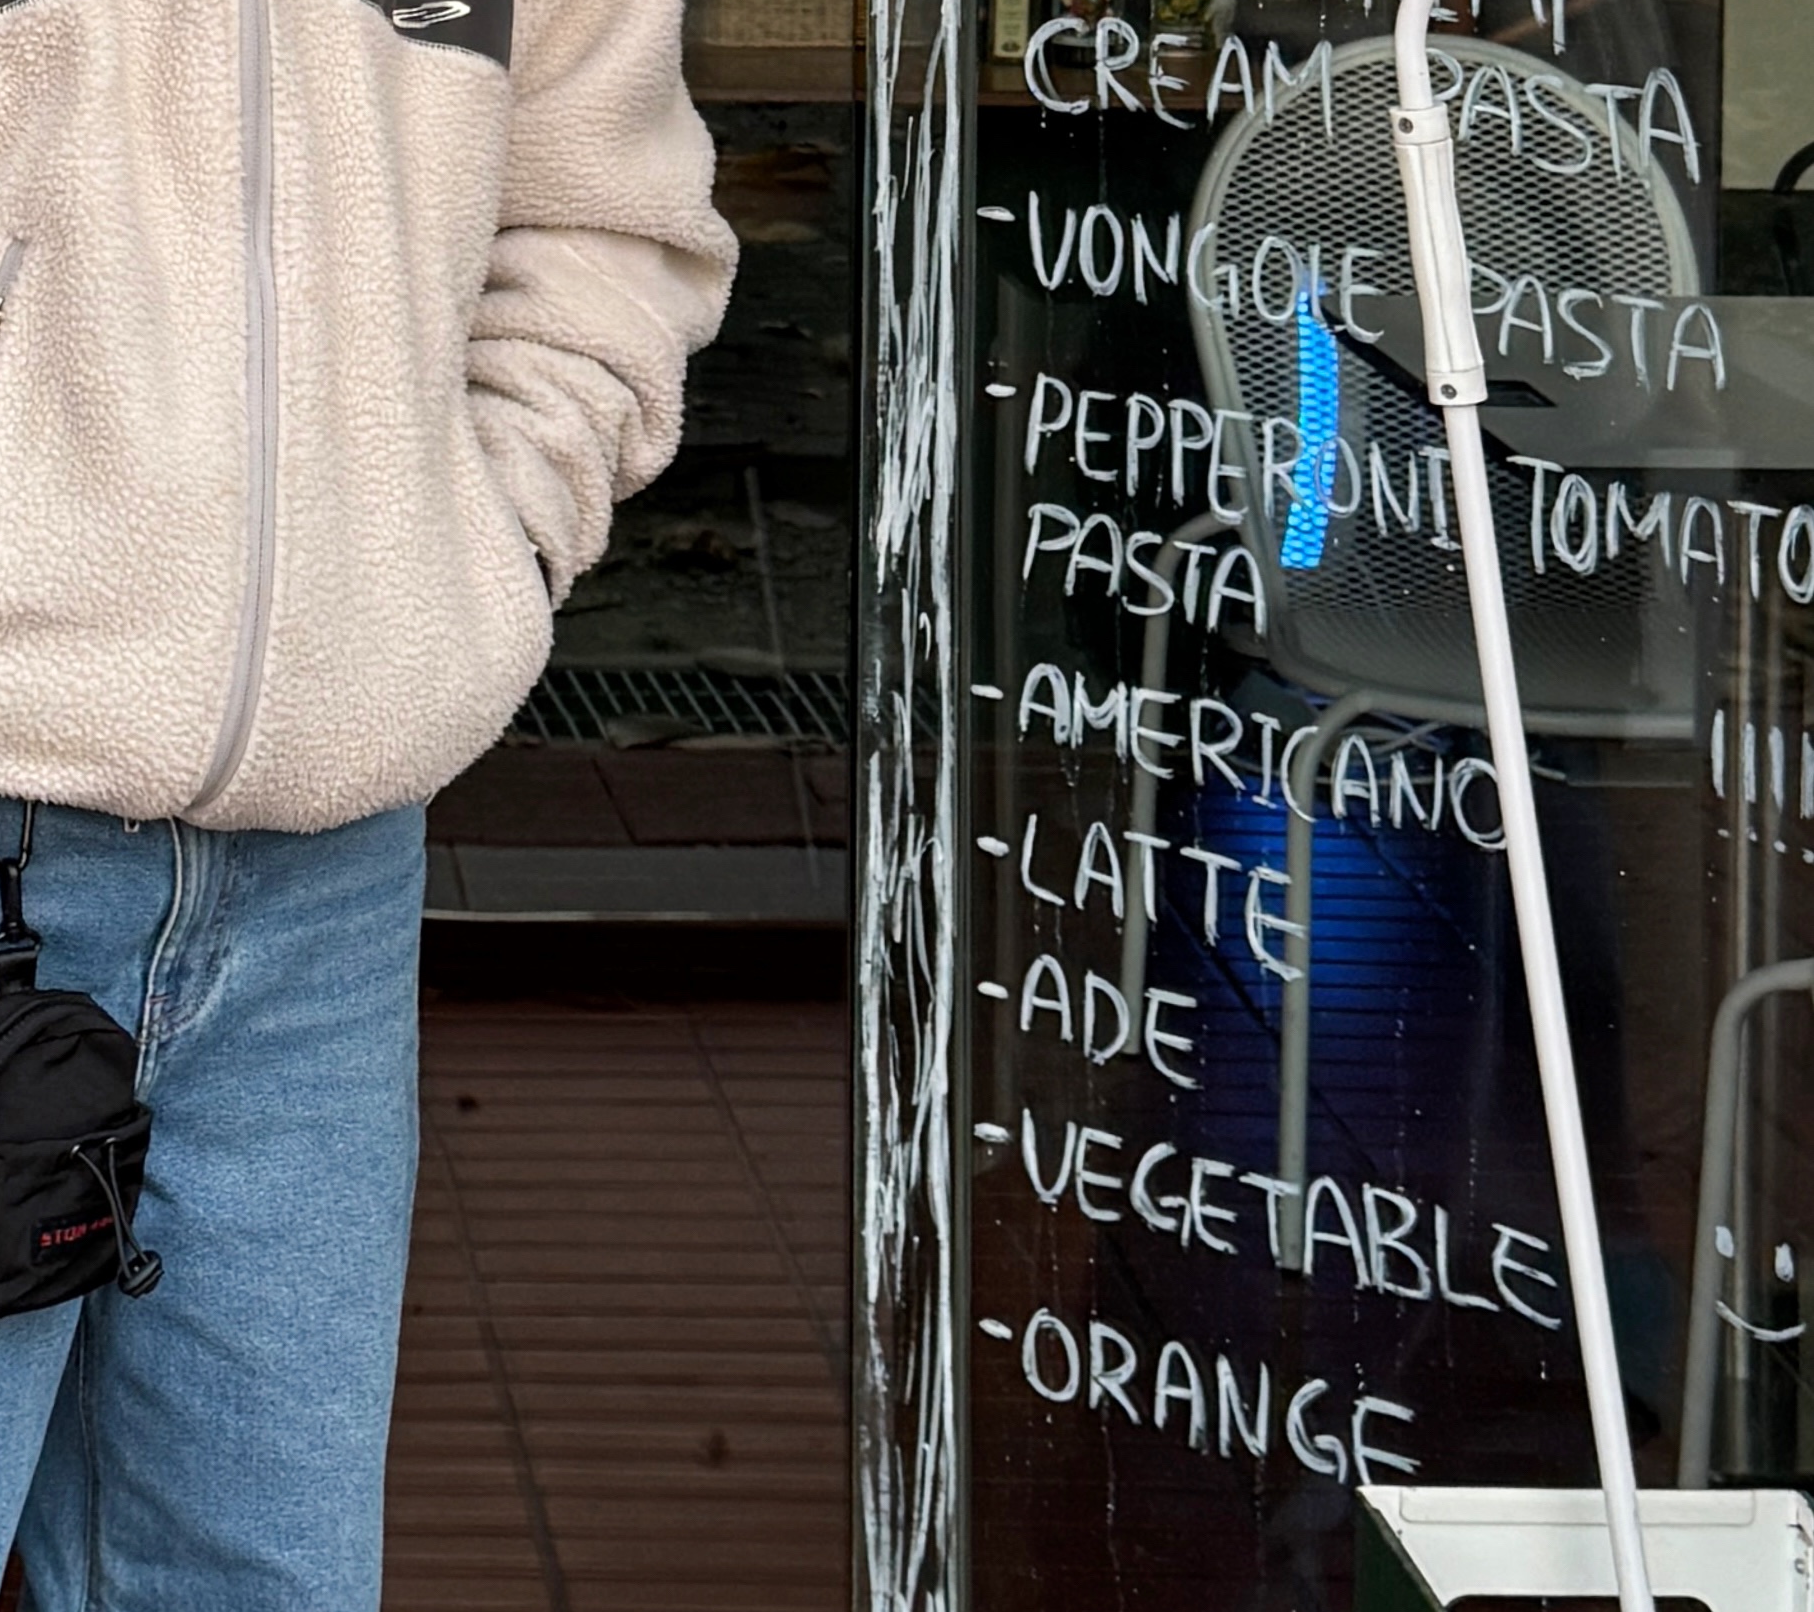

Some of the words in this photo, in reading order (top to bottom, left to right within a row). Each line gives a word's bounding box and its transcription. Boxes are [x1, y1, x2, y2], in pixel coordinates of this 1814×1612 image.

[1024, 16, 1333, 138] CREAM
[1022, 502, 1268, 636] PASTA
[1507, 455, 1814, 604] TOMATO
